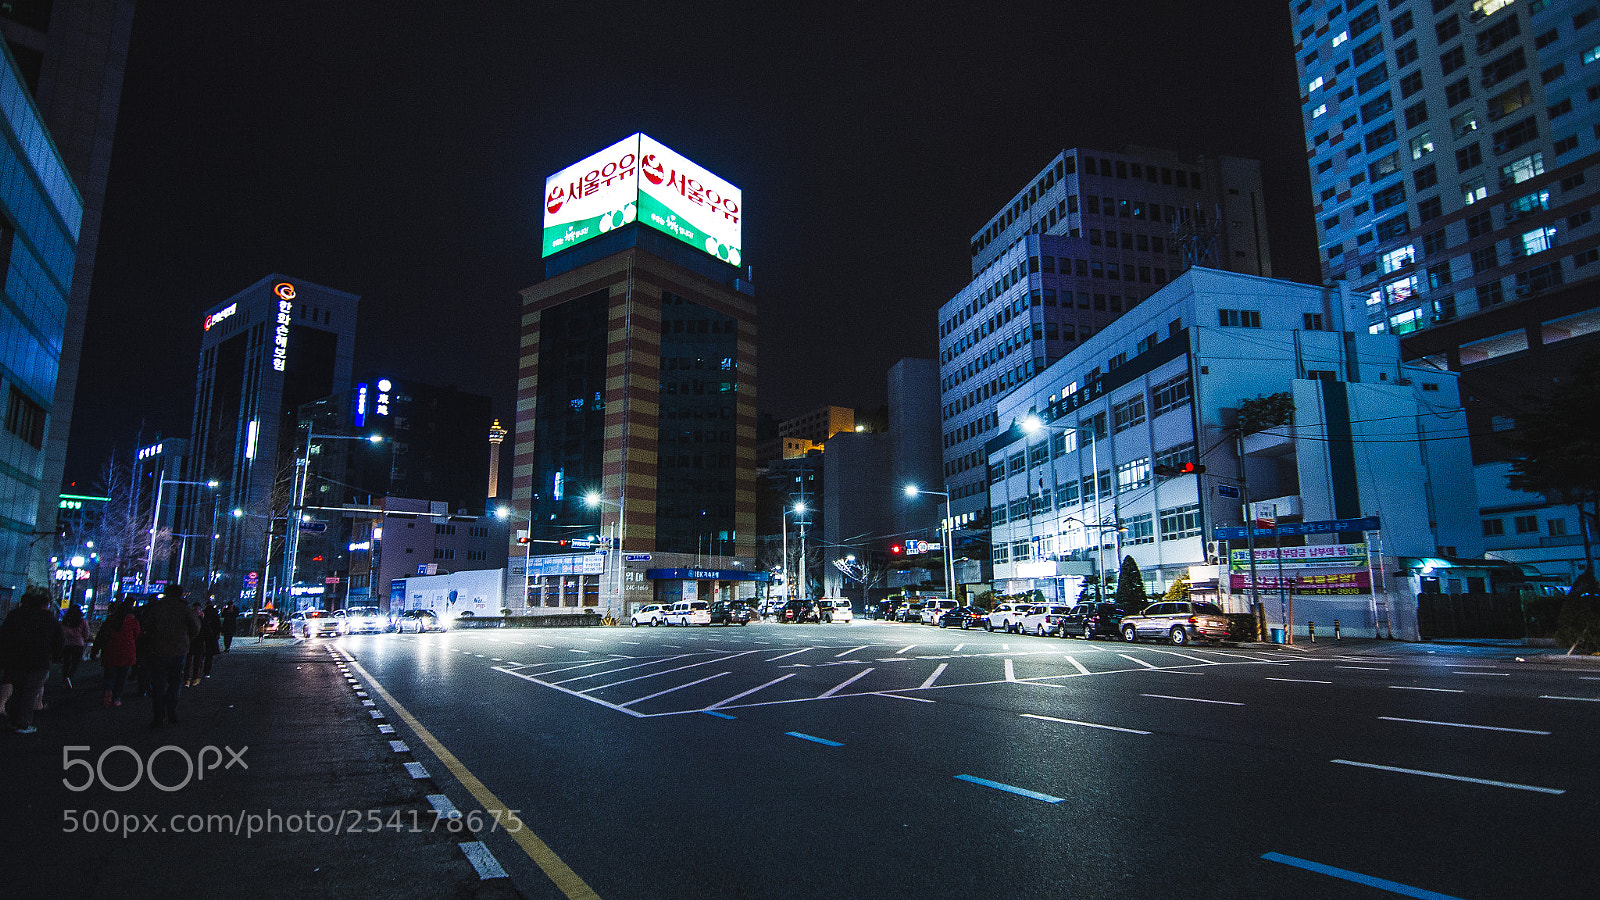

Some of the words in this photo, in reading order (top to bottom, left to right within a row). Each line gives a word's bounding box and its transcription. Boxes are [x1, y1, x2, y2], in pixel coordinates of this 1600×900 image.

[566, 154, 635, 204] 서울우유
[666, 169, 739, 224] 서울우유
[273, 300, 292, 371] 한화손해보험
